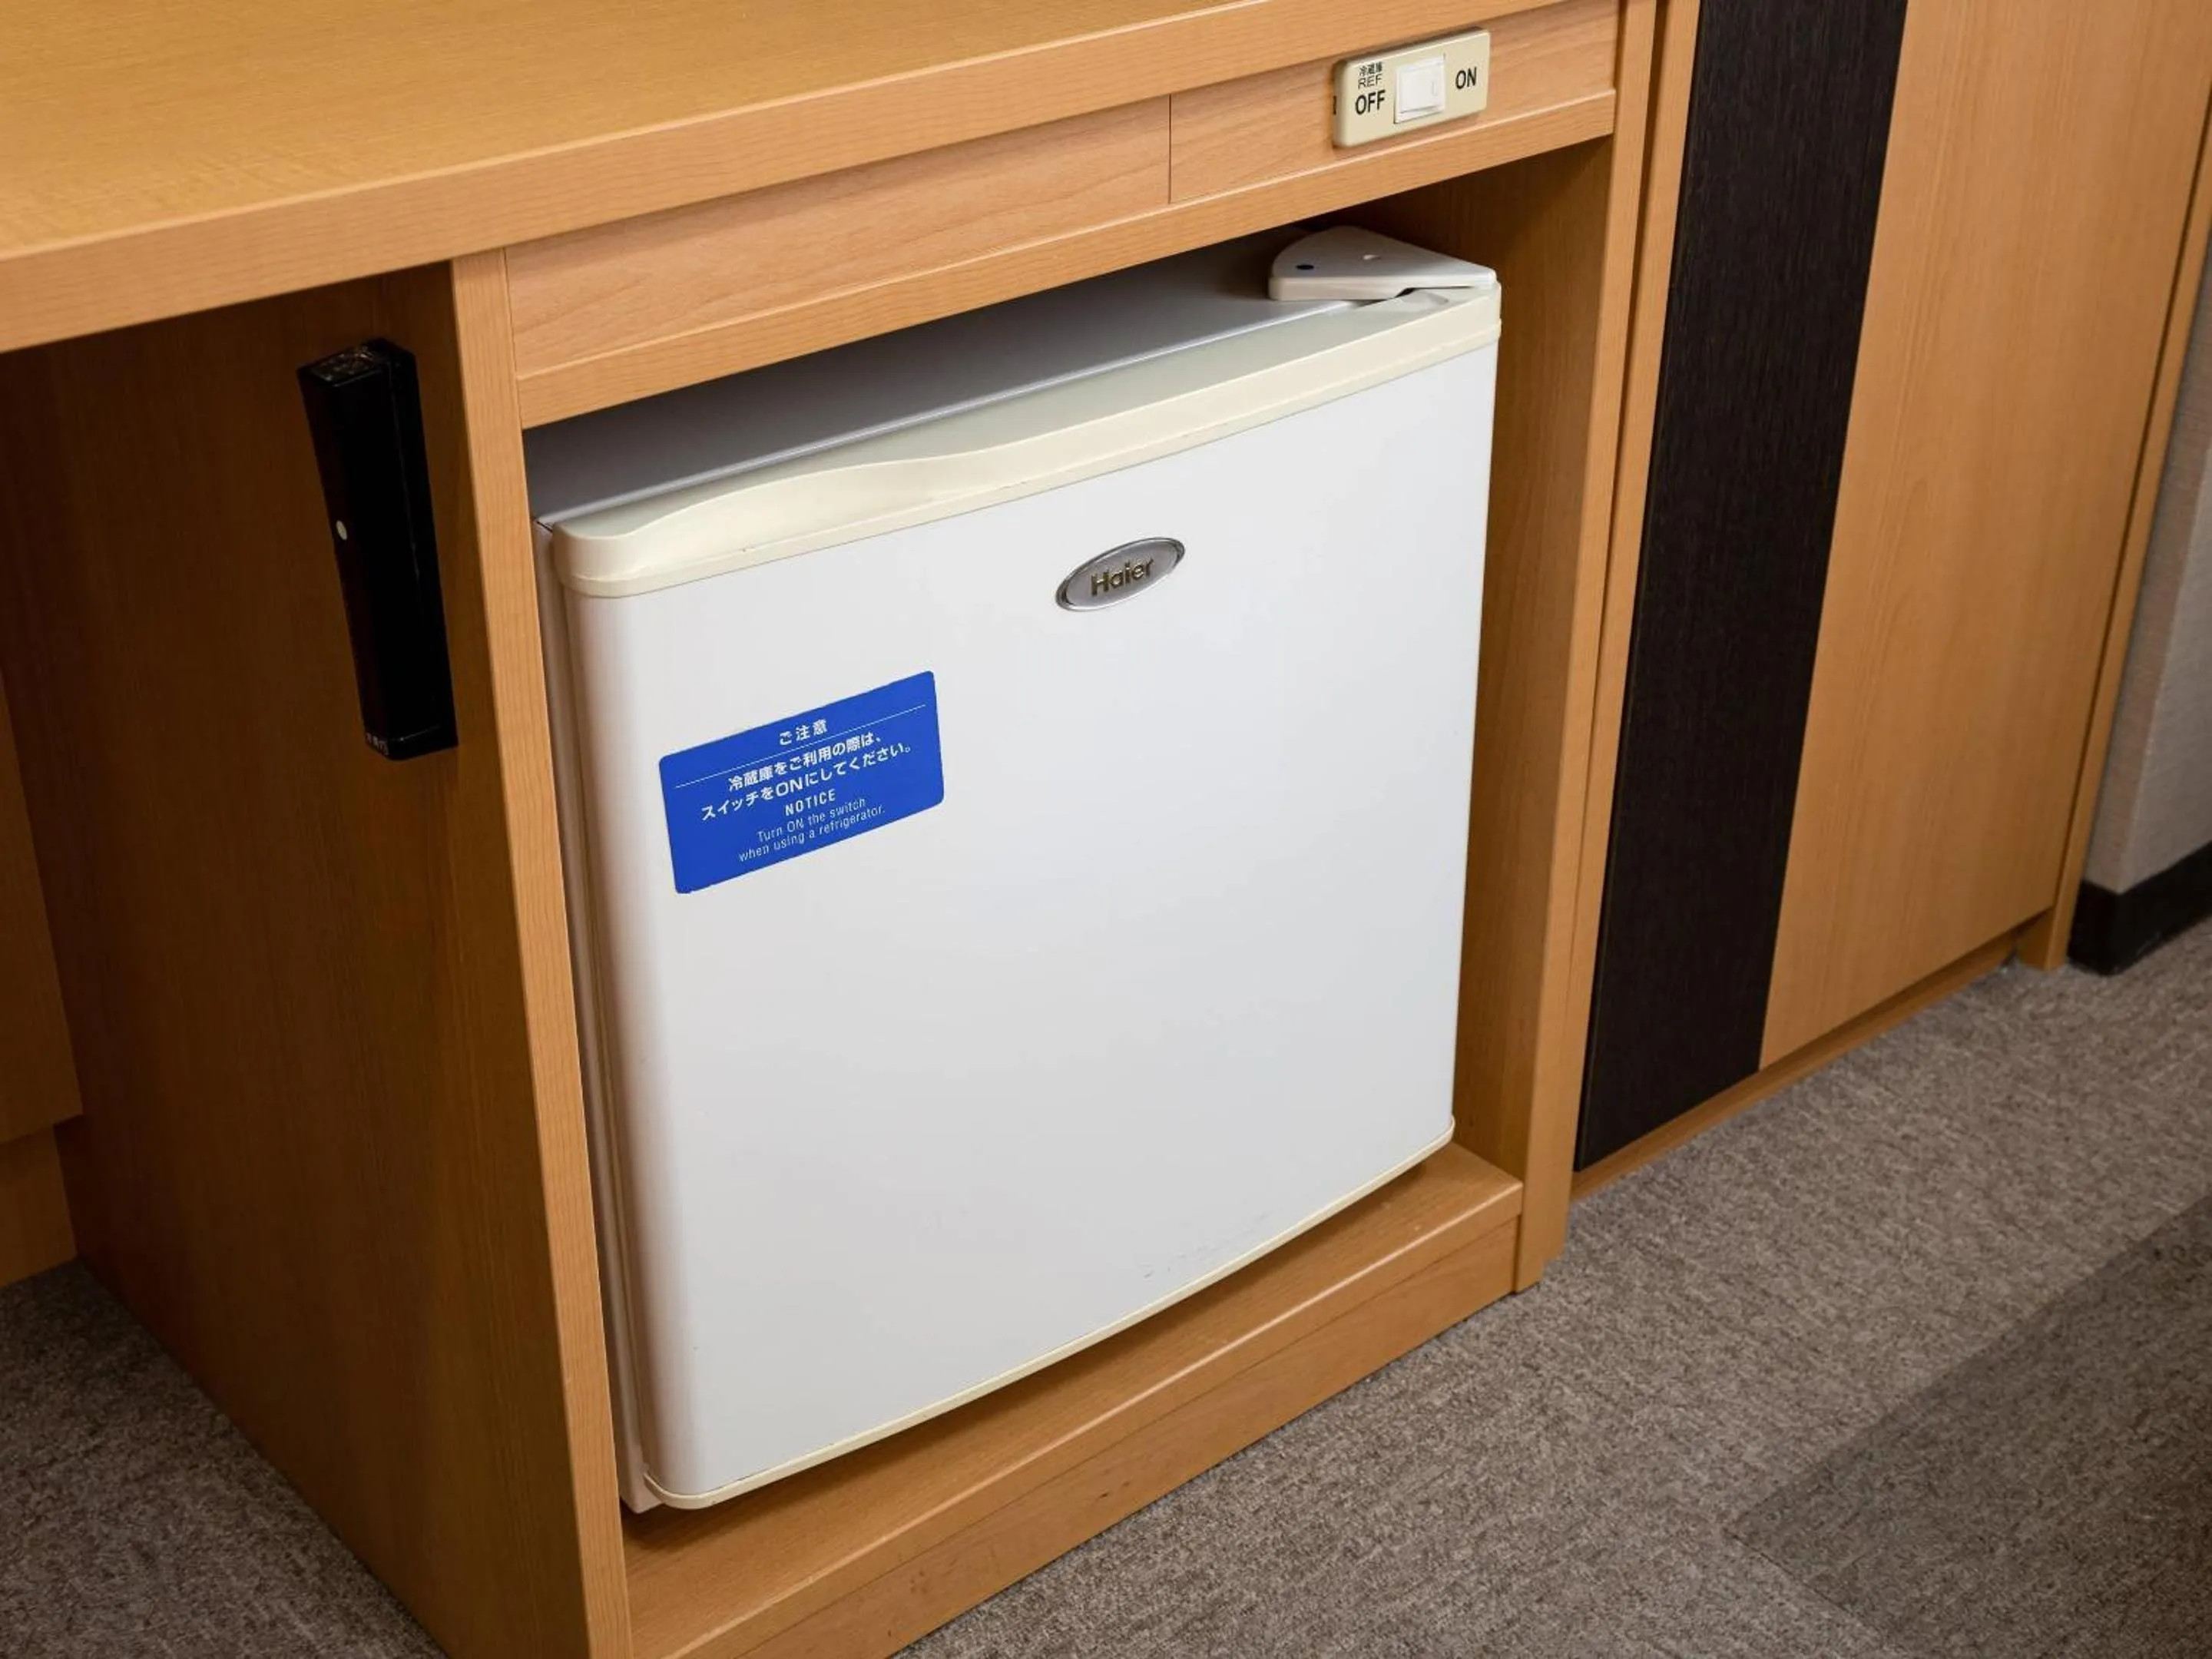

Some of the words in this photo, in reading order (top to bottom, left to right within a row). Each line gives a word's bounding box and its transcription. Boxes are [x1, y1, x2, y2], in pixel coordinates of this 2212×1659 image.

[1358, 75, 1382, 89] REF
[1455, 66, 1477, 90] ON
[1355, 89, 1386, 115] OFF
[1091, 558, 1154, 595] Haier
[778, 719, 829, 745] ご注意
[785, 788, 836, 816] NOTICE
[739, 843, 769, 862] when
[773, 833, 805, 851] using
[819, 805, 886, 836] refrigerator.
[757, 826, 783, 843] Turn
[787, 816, 804, 833] ON
[808, 811, 825, 826] the
[829, 797, 866, 819] switch
